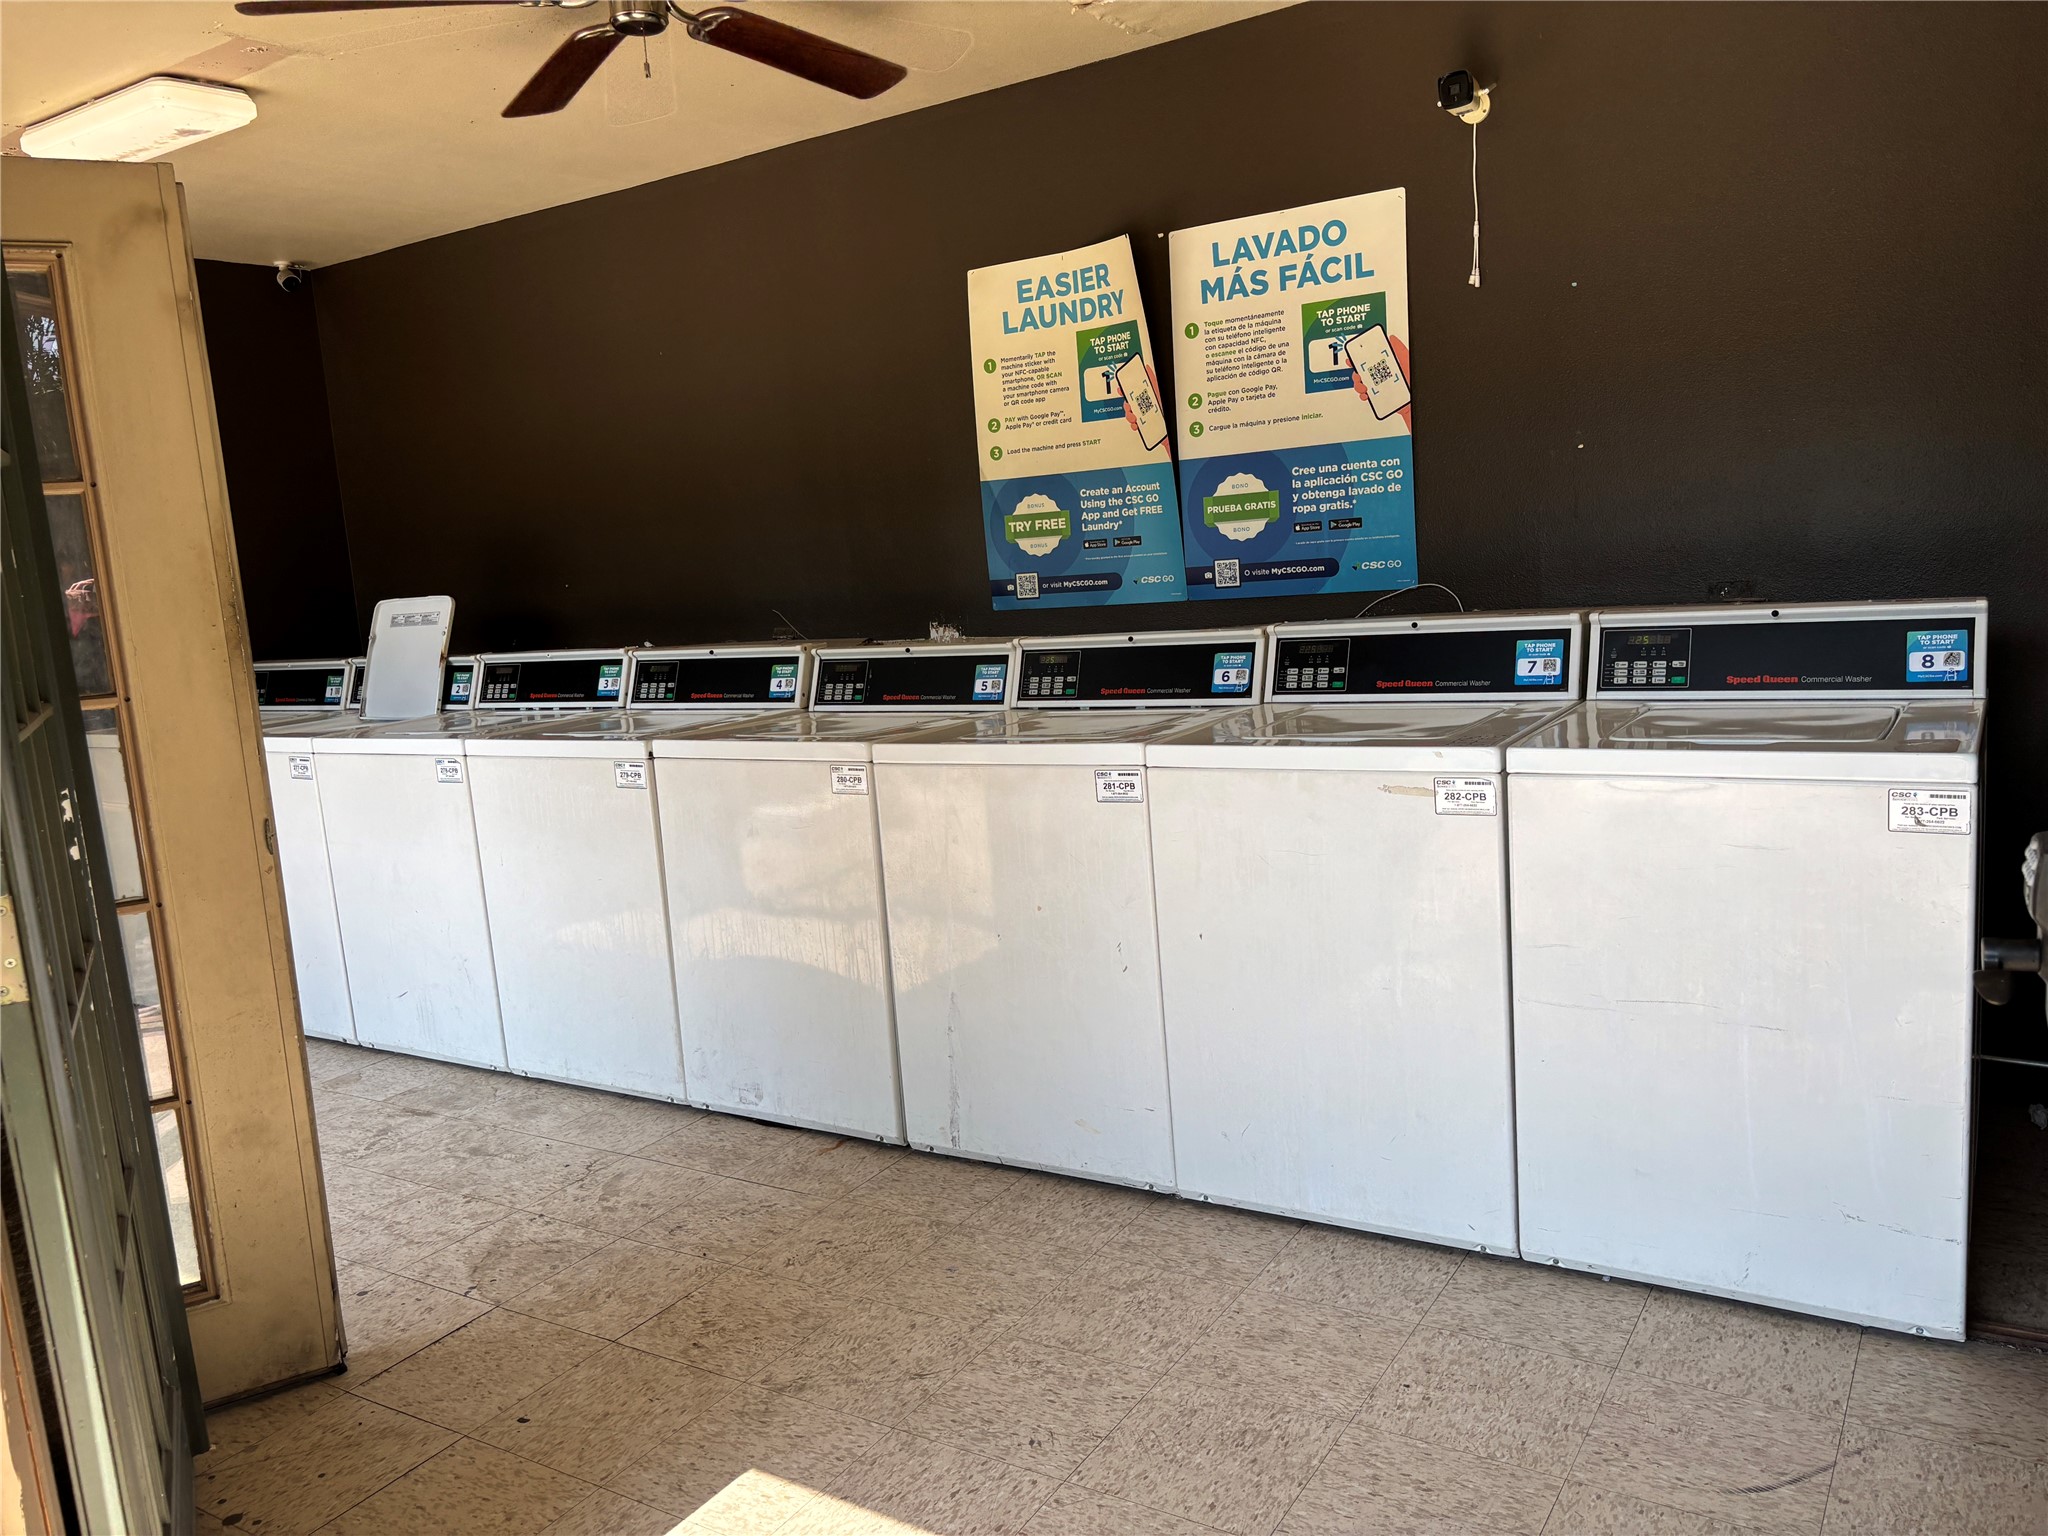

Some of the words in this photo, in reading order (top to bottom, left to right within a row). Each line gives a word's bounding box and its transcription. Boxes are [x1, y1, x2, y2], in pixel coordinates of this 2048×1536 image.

[1212, 219, 1347, 268] LAVADO
[1016, 263, 1111, 304] EASIER
[1200, 266, 1270, 305] MÁS
[1279, 252, 1375, 292] FÁCIL
[1002, 289, 1124, 335] LAUNDRY
[1224, 310, 1284, 324] momentáneamente
[1316, 308, 1334, 320] TAP
[1336, 303, 1370, 317] PHONE
[1320, 317, 1334, 326] TO
[1336, 312, 1366, 324] START
[1089, 336, 1105, 346] TAP
[1106, 332, 1131, 343] PHONE
[1225, 331, 1251, 340] teléfono
[1252, 326, 1286, 336] inteligente
[1094, 345, 1105, 354] TO
[1106, 341, 1129, 352] START
[1000, 353, 1033, 363] Momentarily
[1014, 366, 1049, 376] NFC-capable
[1046, 371, 1062, 379] SCAN
[1206, 373, 1237, 382] aplicación
[1248, 368, 1270, 376] código
[1207, 390, 1226, 398] Pague
[1240, 385, 1263, 394] Google
[1029, 412, 1049, 420] Google
[1042, 418, 1058, 426] credit
[1059, 416, 1072, 424] card
[1239, 419, 1266, 427] máquina
[1272, 415, 1300, 424] presione
[1301, 412, 1323, 420] Iniciar.
[1031, 444, 1054, 452] machine
[1082, 438, 1101, 446] START
[1291, 466, 1316, 476] Cree
[1318, 464, 1338, 473] una
[1340, 460, 1377, 471] cuenta
[1380, 458, 1400, 467] con
[1292, 479, 1301, 488] la
[1303, 473, 1357, 488] aplicación
[1360, 471, 1383, 481] CSC
[1386, 469, 1403, 479] GO
[1079, 487, 1109, 497] Create
[1111, 486, 1123, 494] an
[1124, 481, 1160, 493] Account
[1292, 493, 1299, 502] y
[1301, 489, 1345, 500] obtenga
[1348, 484, 1384, 495] lavado
[1387, 482, 1401, 492] de
[1080, 499, 1106, 508] Using
[1107, 497, 1123, 506] the
[1125, 494, 1144, 504] CSC
[1145, 493, 1159, 502] GO
[1207, 503, 1242, 514] PRUEBA
[1244, 500, 1276, 510] GRATIS
[1081, 511, 1100, 521] App
[1102, 508, 1119, 518] and
[1121, 507, 1138, 516] Get
[1139, 505, 1163, 515] FREE
[1292, 504, 1316, 514] ropa
[1008, 520, 1032, 532] TRY
[1034, 517, 1066, 530] FREE
[1361, 560, 1386, 569] CSC
[1386, 559, 1402, 568] GO
[1141, 575, 1161, 583] CSC
[1162, 574, 1174, 582] GO
[1528, 661, 1538, 674] 7
[1921, 654, 1935, 669] 8
[604, 679, 609, 689] 3
[1222, 671, 1230, 683] 6
[1726, 676, 1761, 685] Speed
[1763, 675, 1799, 684] Queen
[456, 685, 461, 694] 2
[776, 680, 783, 690] 4
[981, 681, 988, 692] 5
[1376, 680, 1404, 689] Speed
[1405, 680, 1434, 688] Queen
[1444, 792, 1487, 801] 282-CPB
[1901, 806, 1959, 817] 283-CPB
